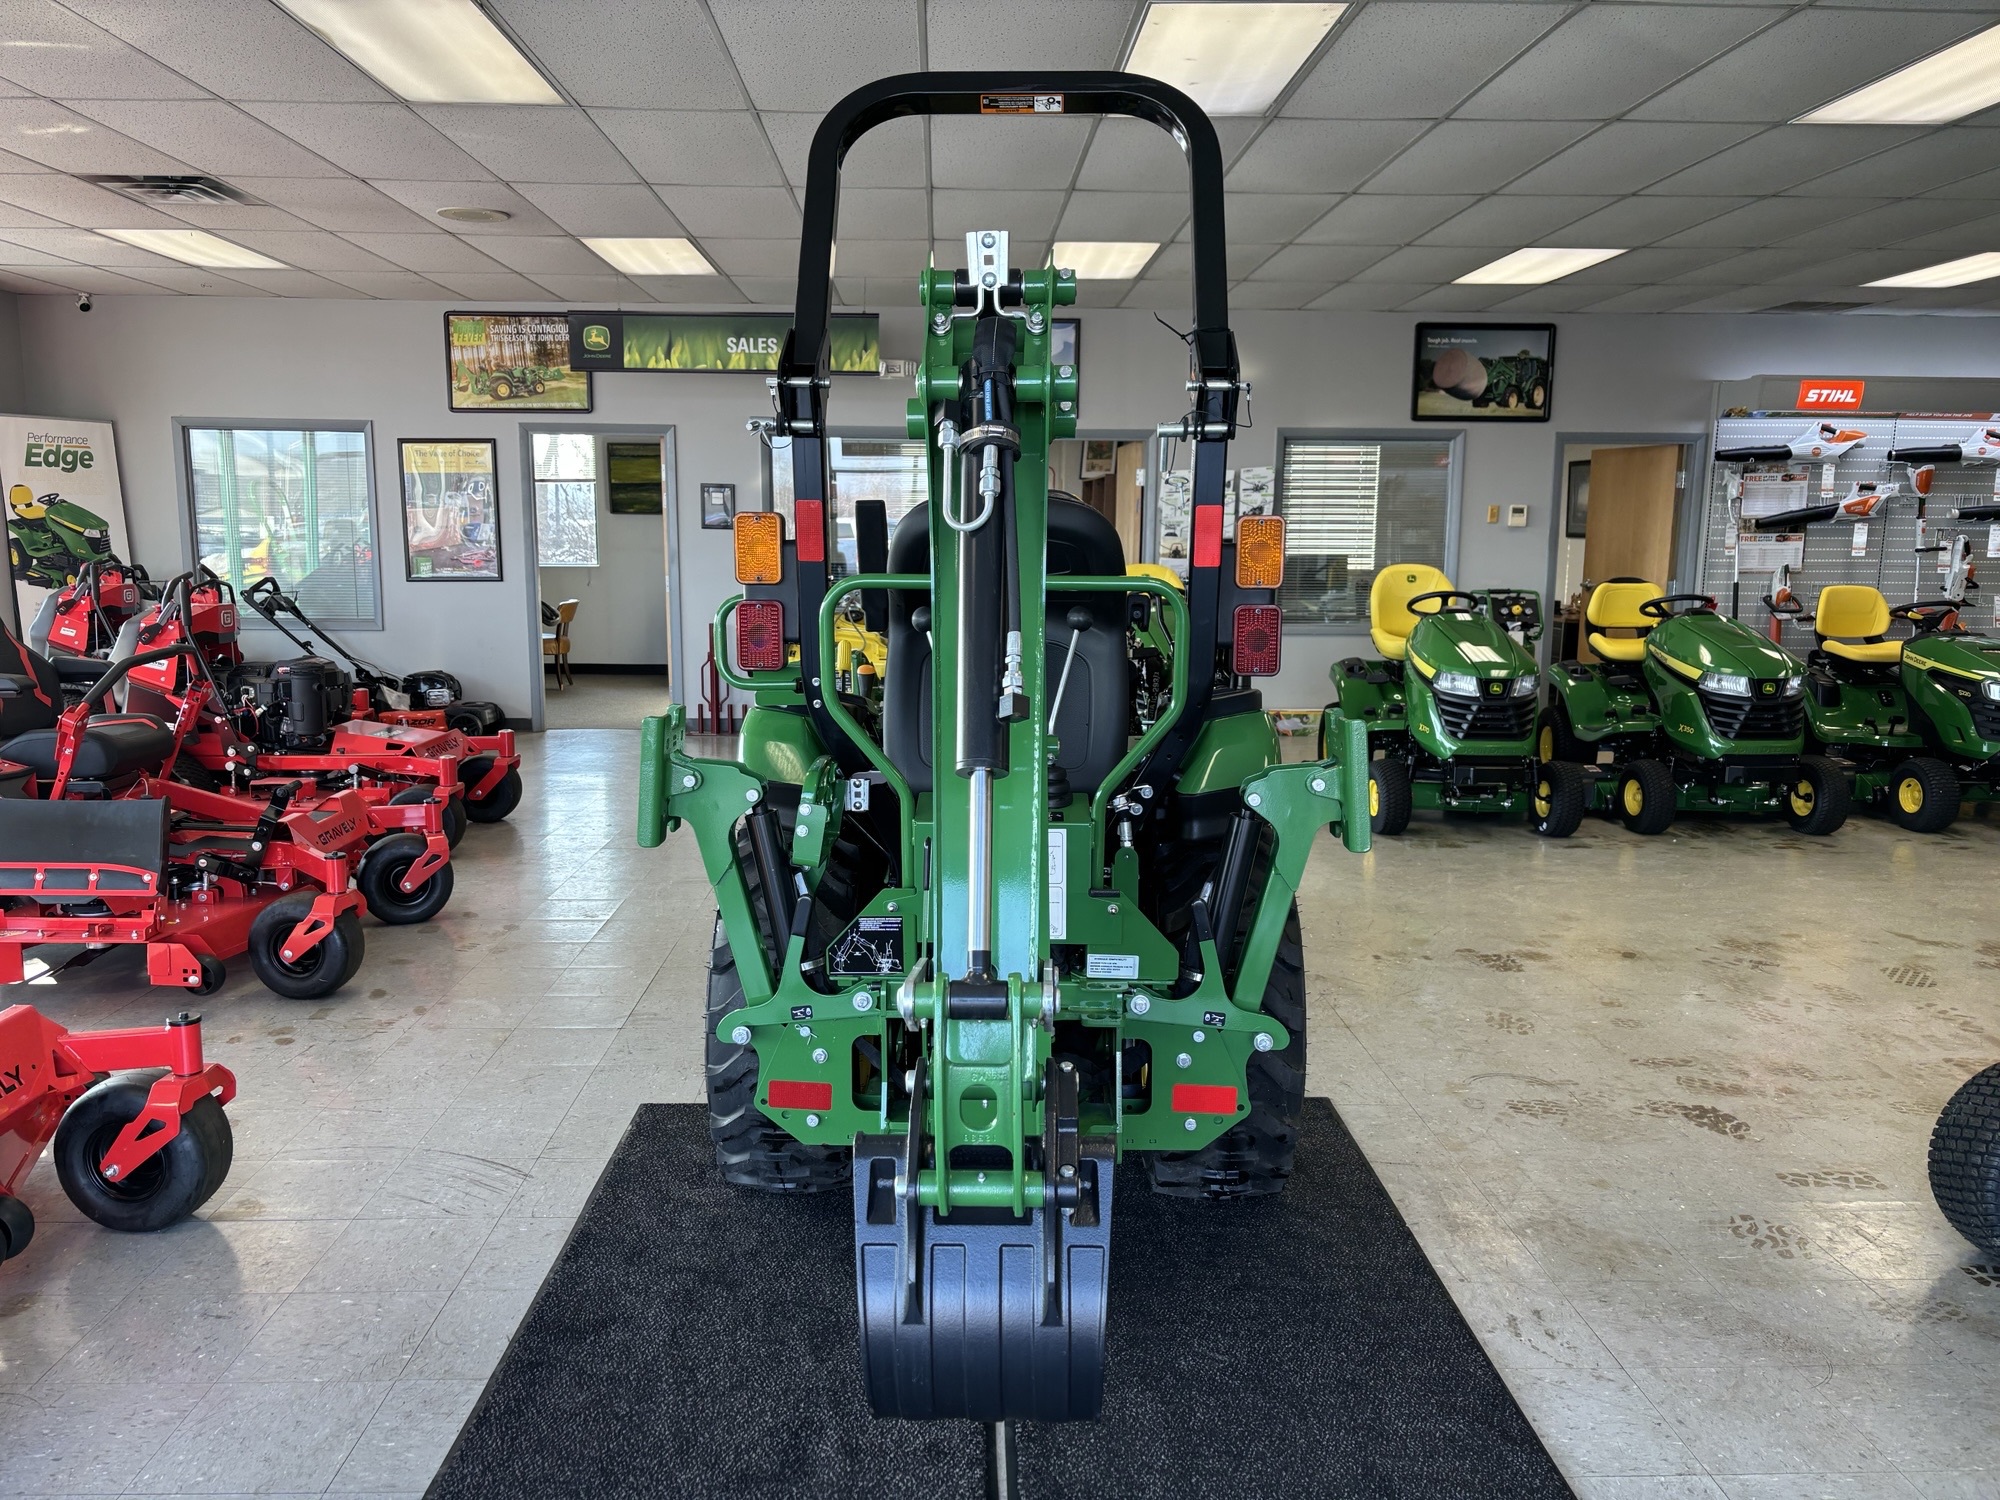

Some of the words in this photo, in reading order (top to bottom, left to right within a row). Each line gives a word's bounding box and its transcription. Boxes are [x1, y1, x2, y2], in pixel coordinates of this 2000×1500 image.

[489, 324, 517, 334] SAVING
[518, 324, 526, 334] IS
[527, 324, 569, 334] CONTAGIOU
[457, 333, 483, 342] FEVER
[505, 333, 528, 341] SEASON
[529, 333, 536, 341] AT
[537, 333, 554, 341] JOHN
[554, 333, 570, 341] DEER
[726, 337, 778, 354] SALES
[1805, 389, 1857, 403] STIHL
[27, 432, 89, 446] Performance
[24, 442, 94, 473] Edge
[415, 449, 428, 457] The
[429, 449, 447, 457] Vaue
[448, 449, 456, 457] of
[457, 449, 480, 457] Choice
[1914, 656, 1927, 666] DEERE
[396, 718, 437, 727] RAZOR
[1678, 723, 1695, 734] X350
[425, 737, 461, 757] GRAVELY
[317, 817, 358, 846] GRAVELY
